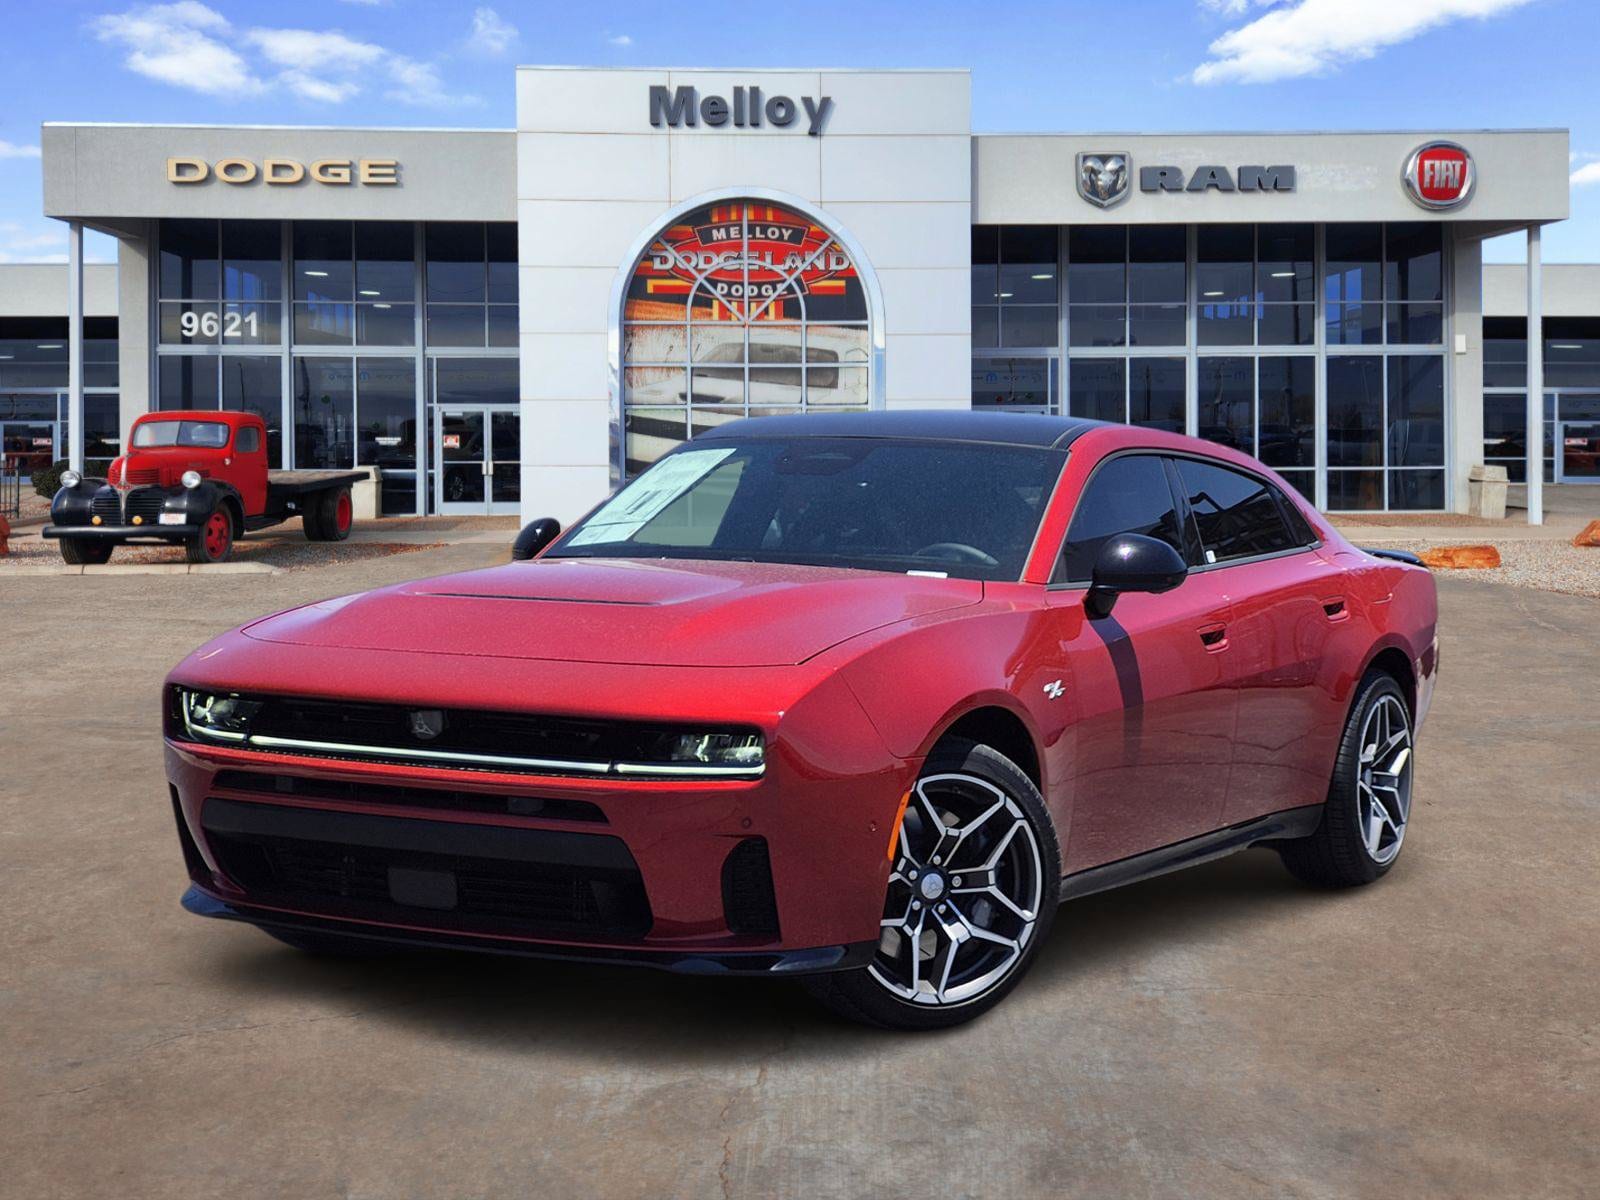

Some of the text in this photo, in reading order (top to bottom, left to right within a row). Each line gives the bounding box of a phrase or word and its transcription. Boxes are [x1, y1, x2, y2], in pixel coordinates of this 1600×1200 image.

[649, 85, 832, 136] Melloy
[166, 158, 398, 185] DODGE
[1139, 165, 1296, 192] RAM
[1423, 159, 1464, 189] FIAT
[180, 311, 258, 337] 9621
